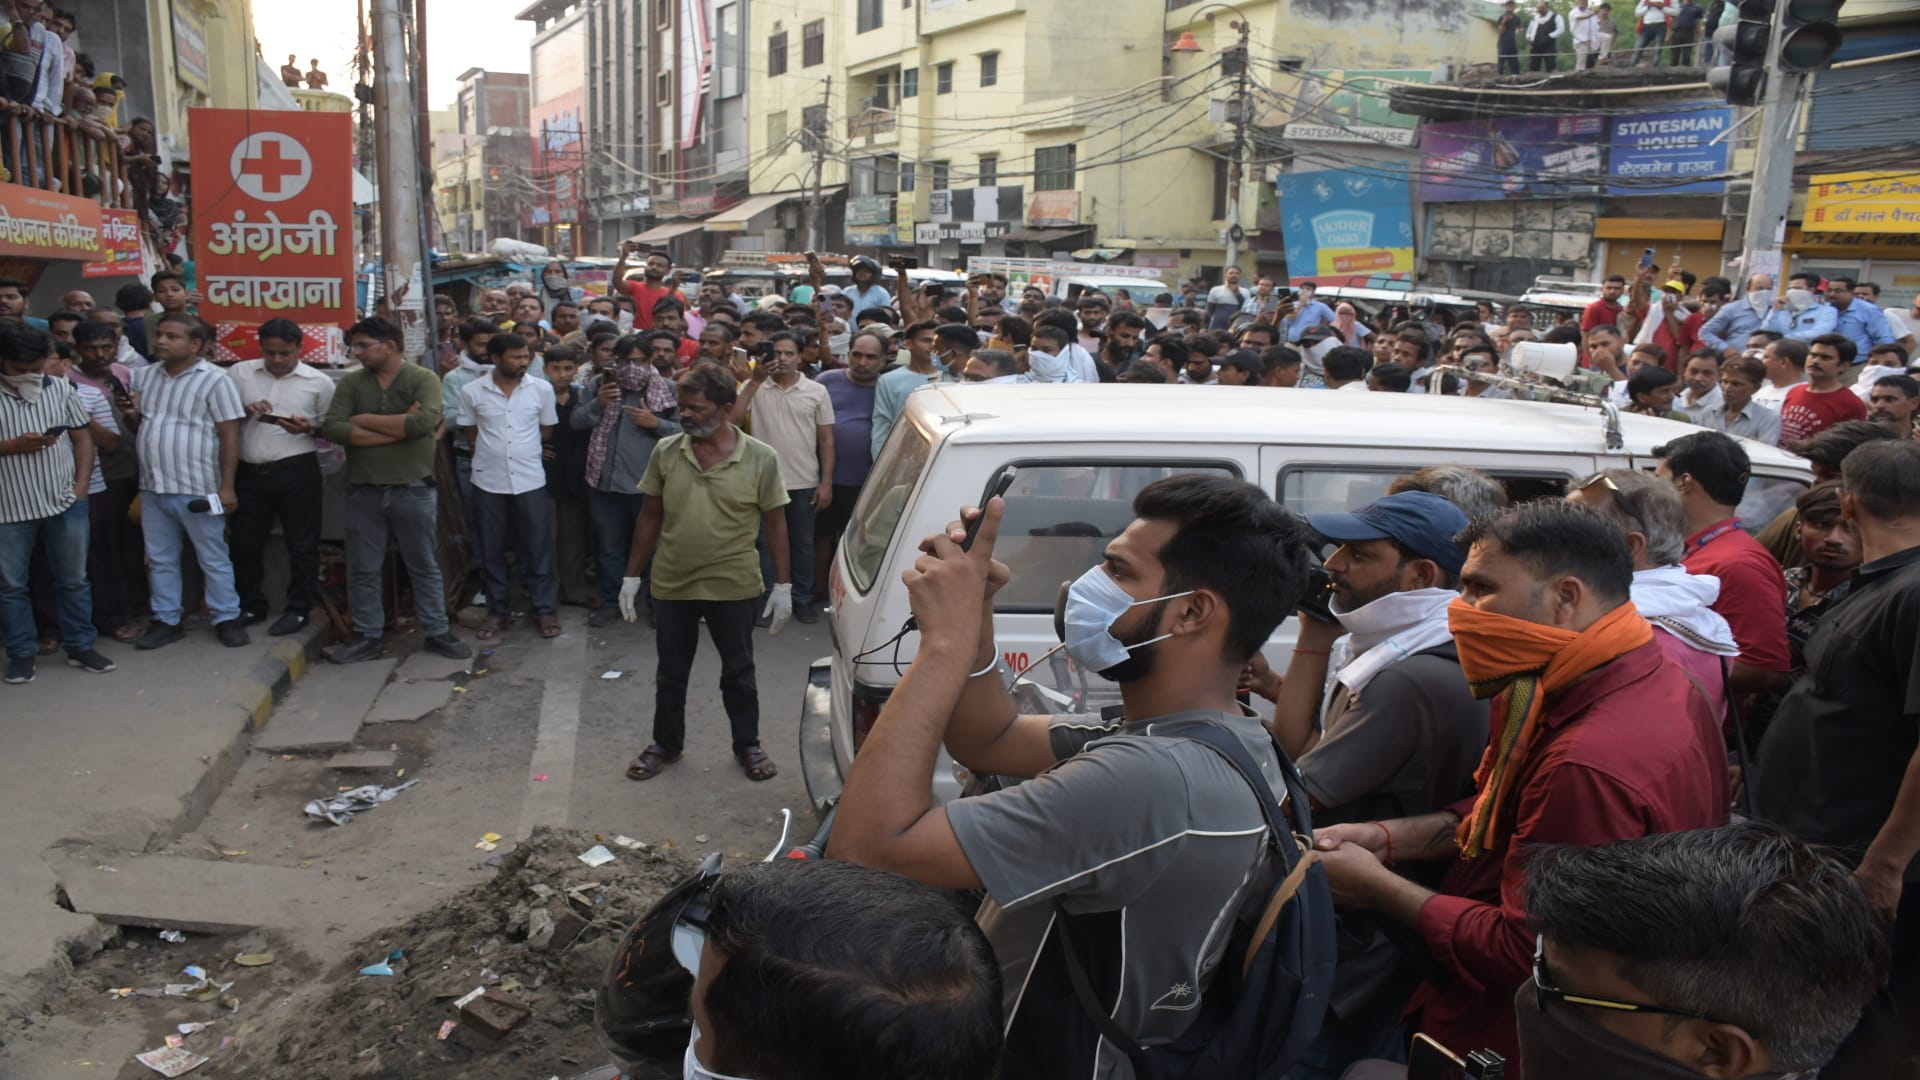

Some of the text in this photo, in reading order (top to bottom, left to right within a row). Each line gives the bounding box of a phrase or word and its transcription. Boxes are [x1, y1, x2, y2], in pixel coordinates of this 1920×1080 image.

[1290, 126, 1406, 142] STATESMAN HOUSE
[1618, 116, 1723, 136] STATESMAN
[1637, 135, 1698, 150] HOUSE
[1834, 181, 1854, 194] Dr
[1856, 181, 1885, 195] Lal
[0, 204, 52, 247] नेशनल
[1318, 220, 1368, 233] MOTHER
[208, 209, 338, 262] अंग्रेजी
[1328, 233, 1359, 245] DAIRY
[205, 275, 342, 310] दवाखाना
